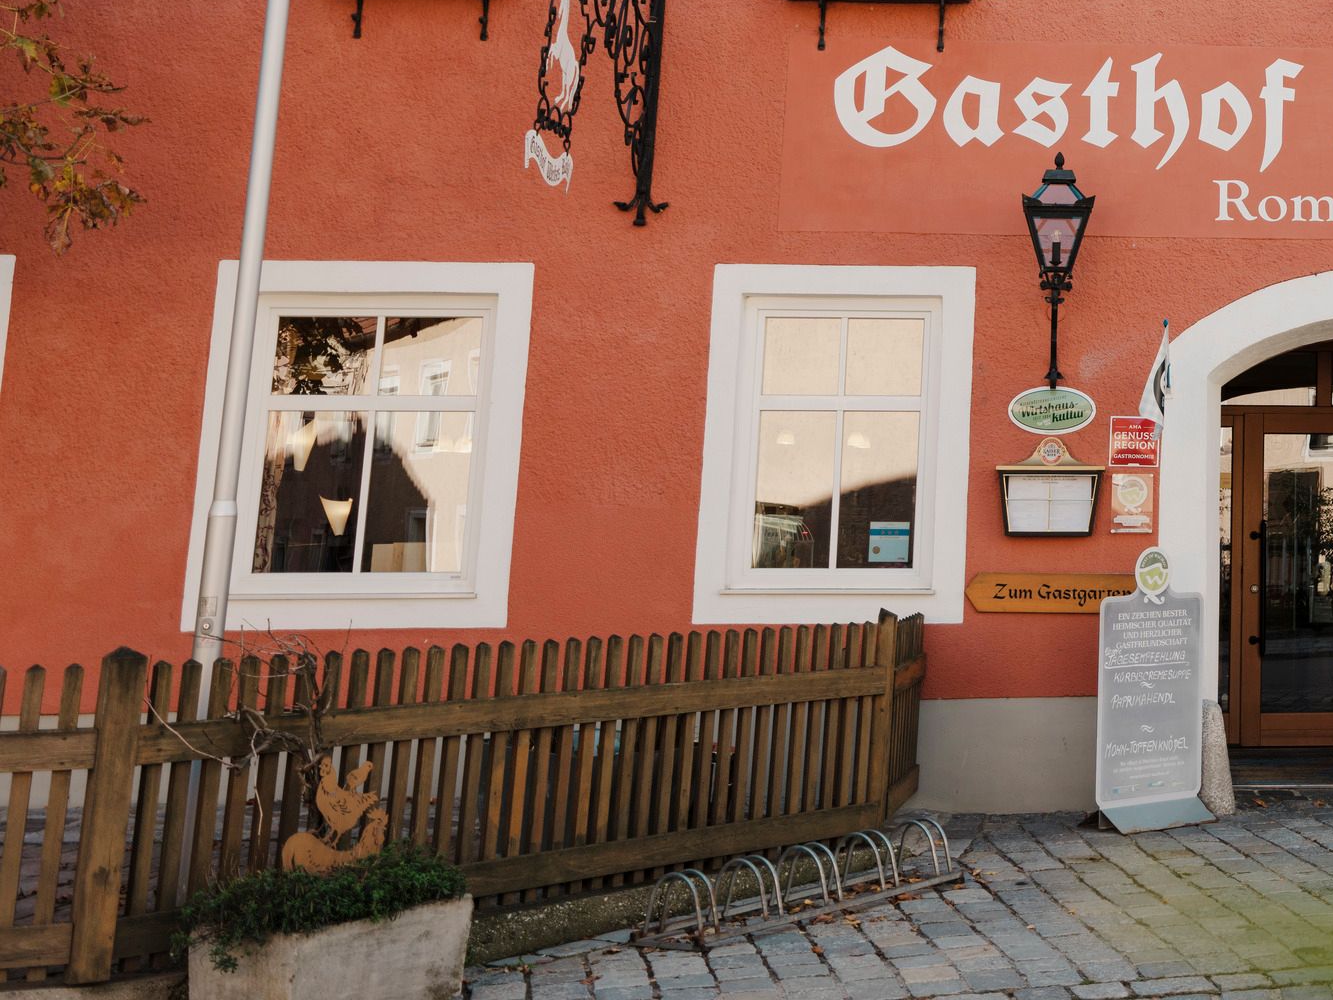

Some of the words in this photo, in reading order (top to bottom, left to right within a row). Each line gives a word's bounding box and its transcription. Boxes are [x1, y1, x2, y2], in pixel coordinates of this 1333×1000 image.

[833, 46, 1304, 173] Gasthof
[1114, 431, 1155, 440] GENUSS
[1114, 441, 1155, 450] REGION
[992, 583, 1033, 599] Zum
[1118, 612, 1130, 621] EIN
[1131, 611, 1161, 620] ZEICHEN
[1163, 609, 1188, 617] BESTER
[1112, 620, 1157, 630] HEIMISCHER
[1123, 631, 1139, 639] UND
[1140, 628, 1182, 638] HERZLICHER
[1116, 637, 1188, 649] GASTFREUNDSCHAFT
